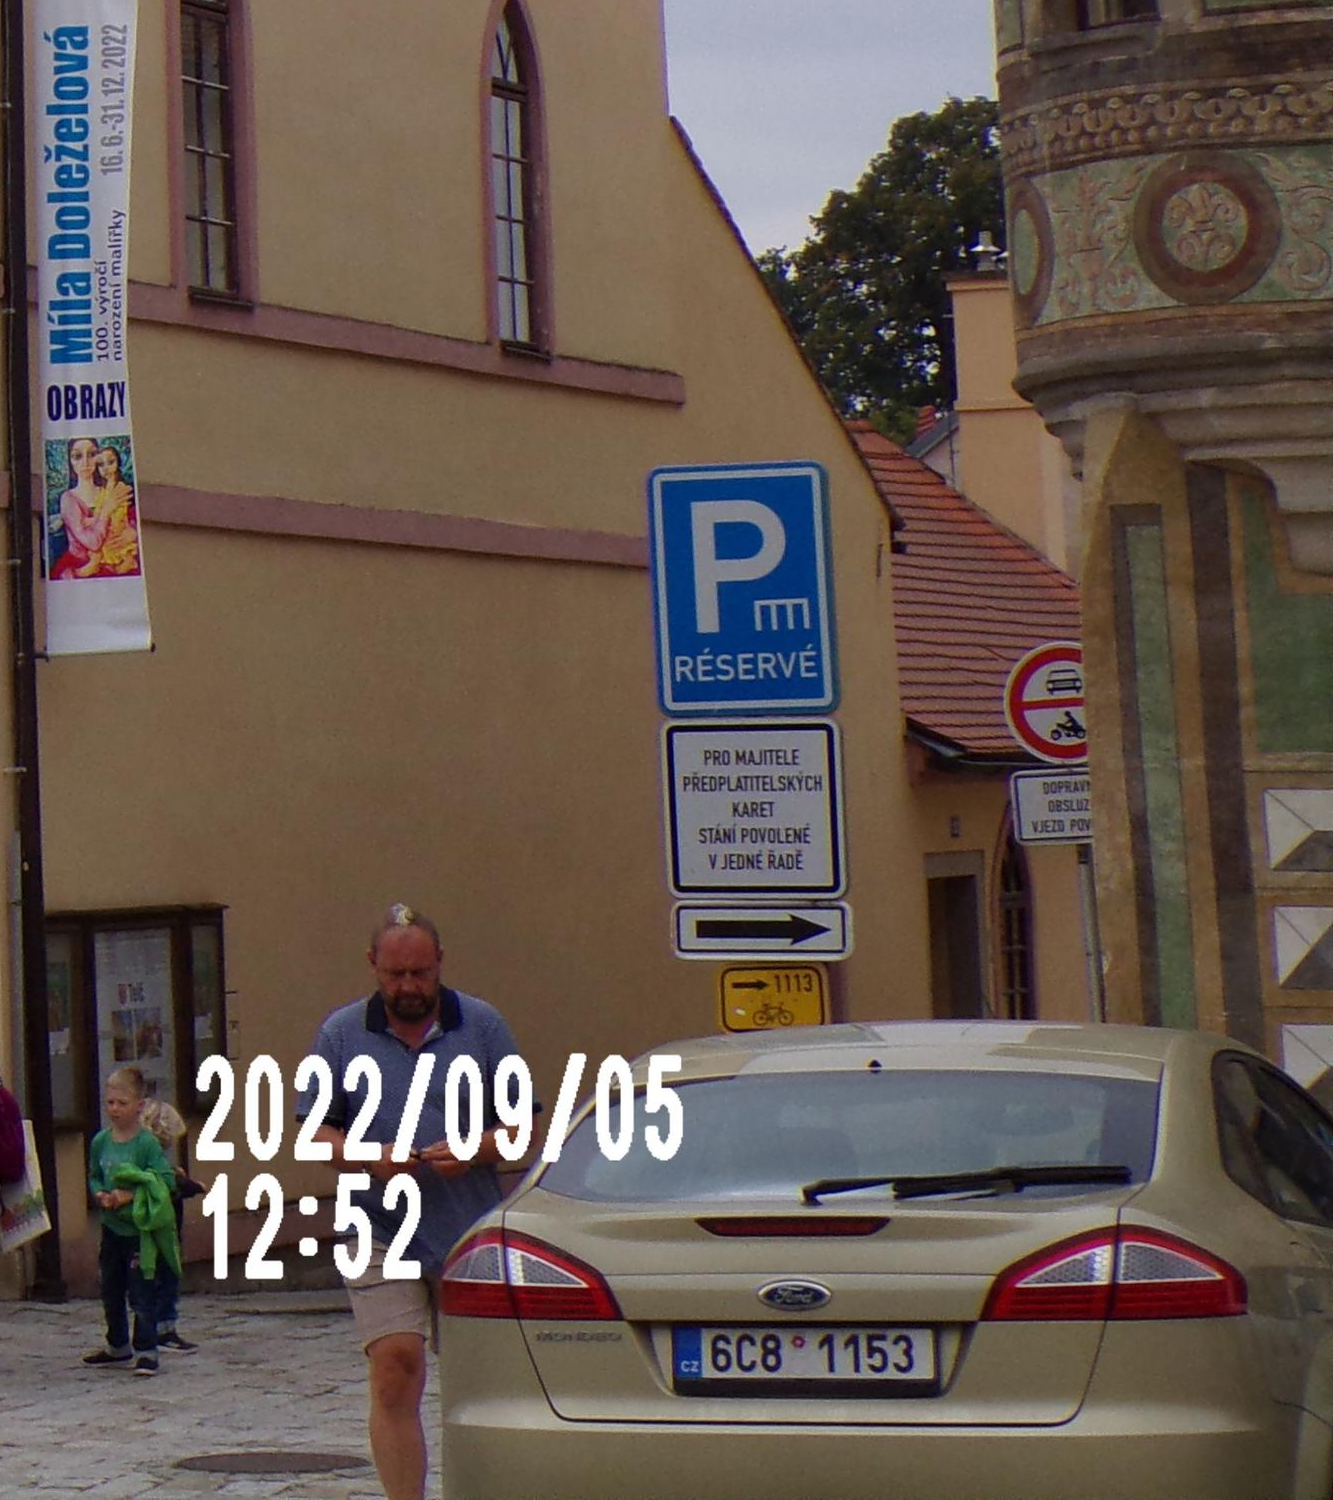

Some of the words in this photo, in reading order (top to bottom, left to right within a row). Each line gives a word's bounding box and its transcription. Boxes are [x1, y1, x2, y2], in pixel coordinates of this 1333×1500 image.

[43, 25, 91, 260] Doleželová
[107, 210, 126, 277] malířky
[94, 261, 110, 315] výročí
[47, 272, 93, 364] Míla
[108, 283, 122, 361] narození
[95, 322, 110, 361] 100.
[46, 381, 126, 422] OBRAZY
[691, 498, 787, 634] P
[674, 644, 819, 683] RÉSERVÉ
[703, 750, 731, 767] PRO
[735, 748, 800, 766] MAJITELE
[682, 771, 823, 793] PŘEDPLATITELSKÝCH
[732, 801, 775, 818] KARET
[1031, 819, 1065, 834] VJEZD
[698, 823, 737, 844] STÁNÍ
[741, 822, 811, 844] POVOLENÉ
[708, 853, 718, 870] V
[721, 848, 763, 870] JEDNÉ
[767, 848, 804, 870] ŘADĚ
[773, 973, 813, 994] 1113
[680, 1361, 700, 1373] CZ
[710, 1333, 783, 1374] 6C8
[817, 1333, 916, 1374] 1153
